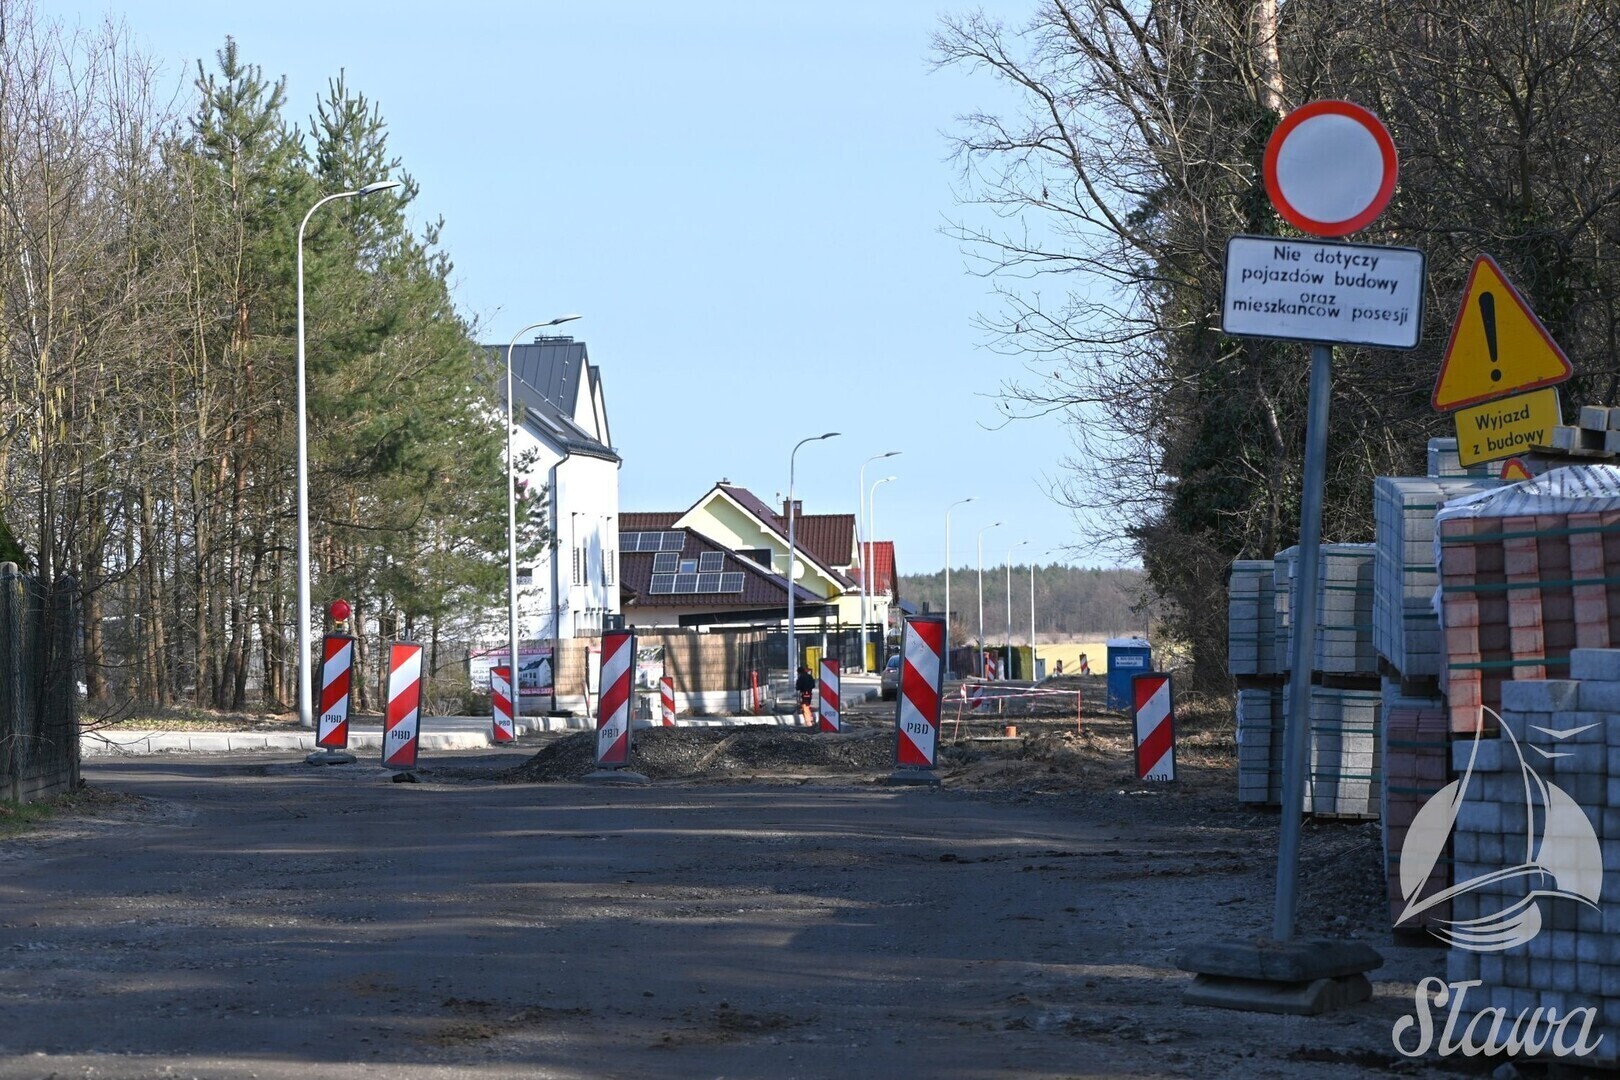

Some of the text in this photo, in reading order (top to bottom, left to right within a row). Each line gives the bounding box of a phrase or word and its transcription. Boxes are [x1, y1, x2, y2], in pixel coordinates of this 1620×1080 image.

[1274, 245, 1379, 271] Nie dotyczy
[1242, 265, 1398, 295] pojazdów budowy
[1300, 292, 1336, 305] oraz
[1352, 307, 1408, 326] posesji
[1475, 404, 1530, 431] Wyjazd
[1473, 429, 1544, 455] z budowy
[325, 714, 342, 723] PBD
[391, 730, 410, 740] PBD
[602, 728, 619, 739] PBD
[906, 722, 929, 735] PBD
